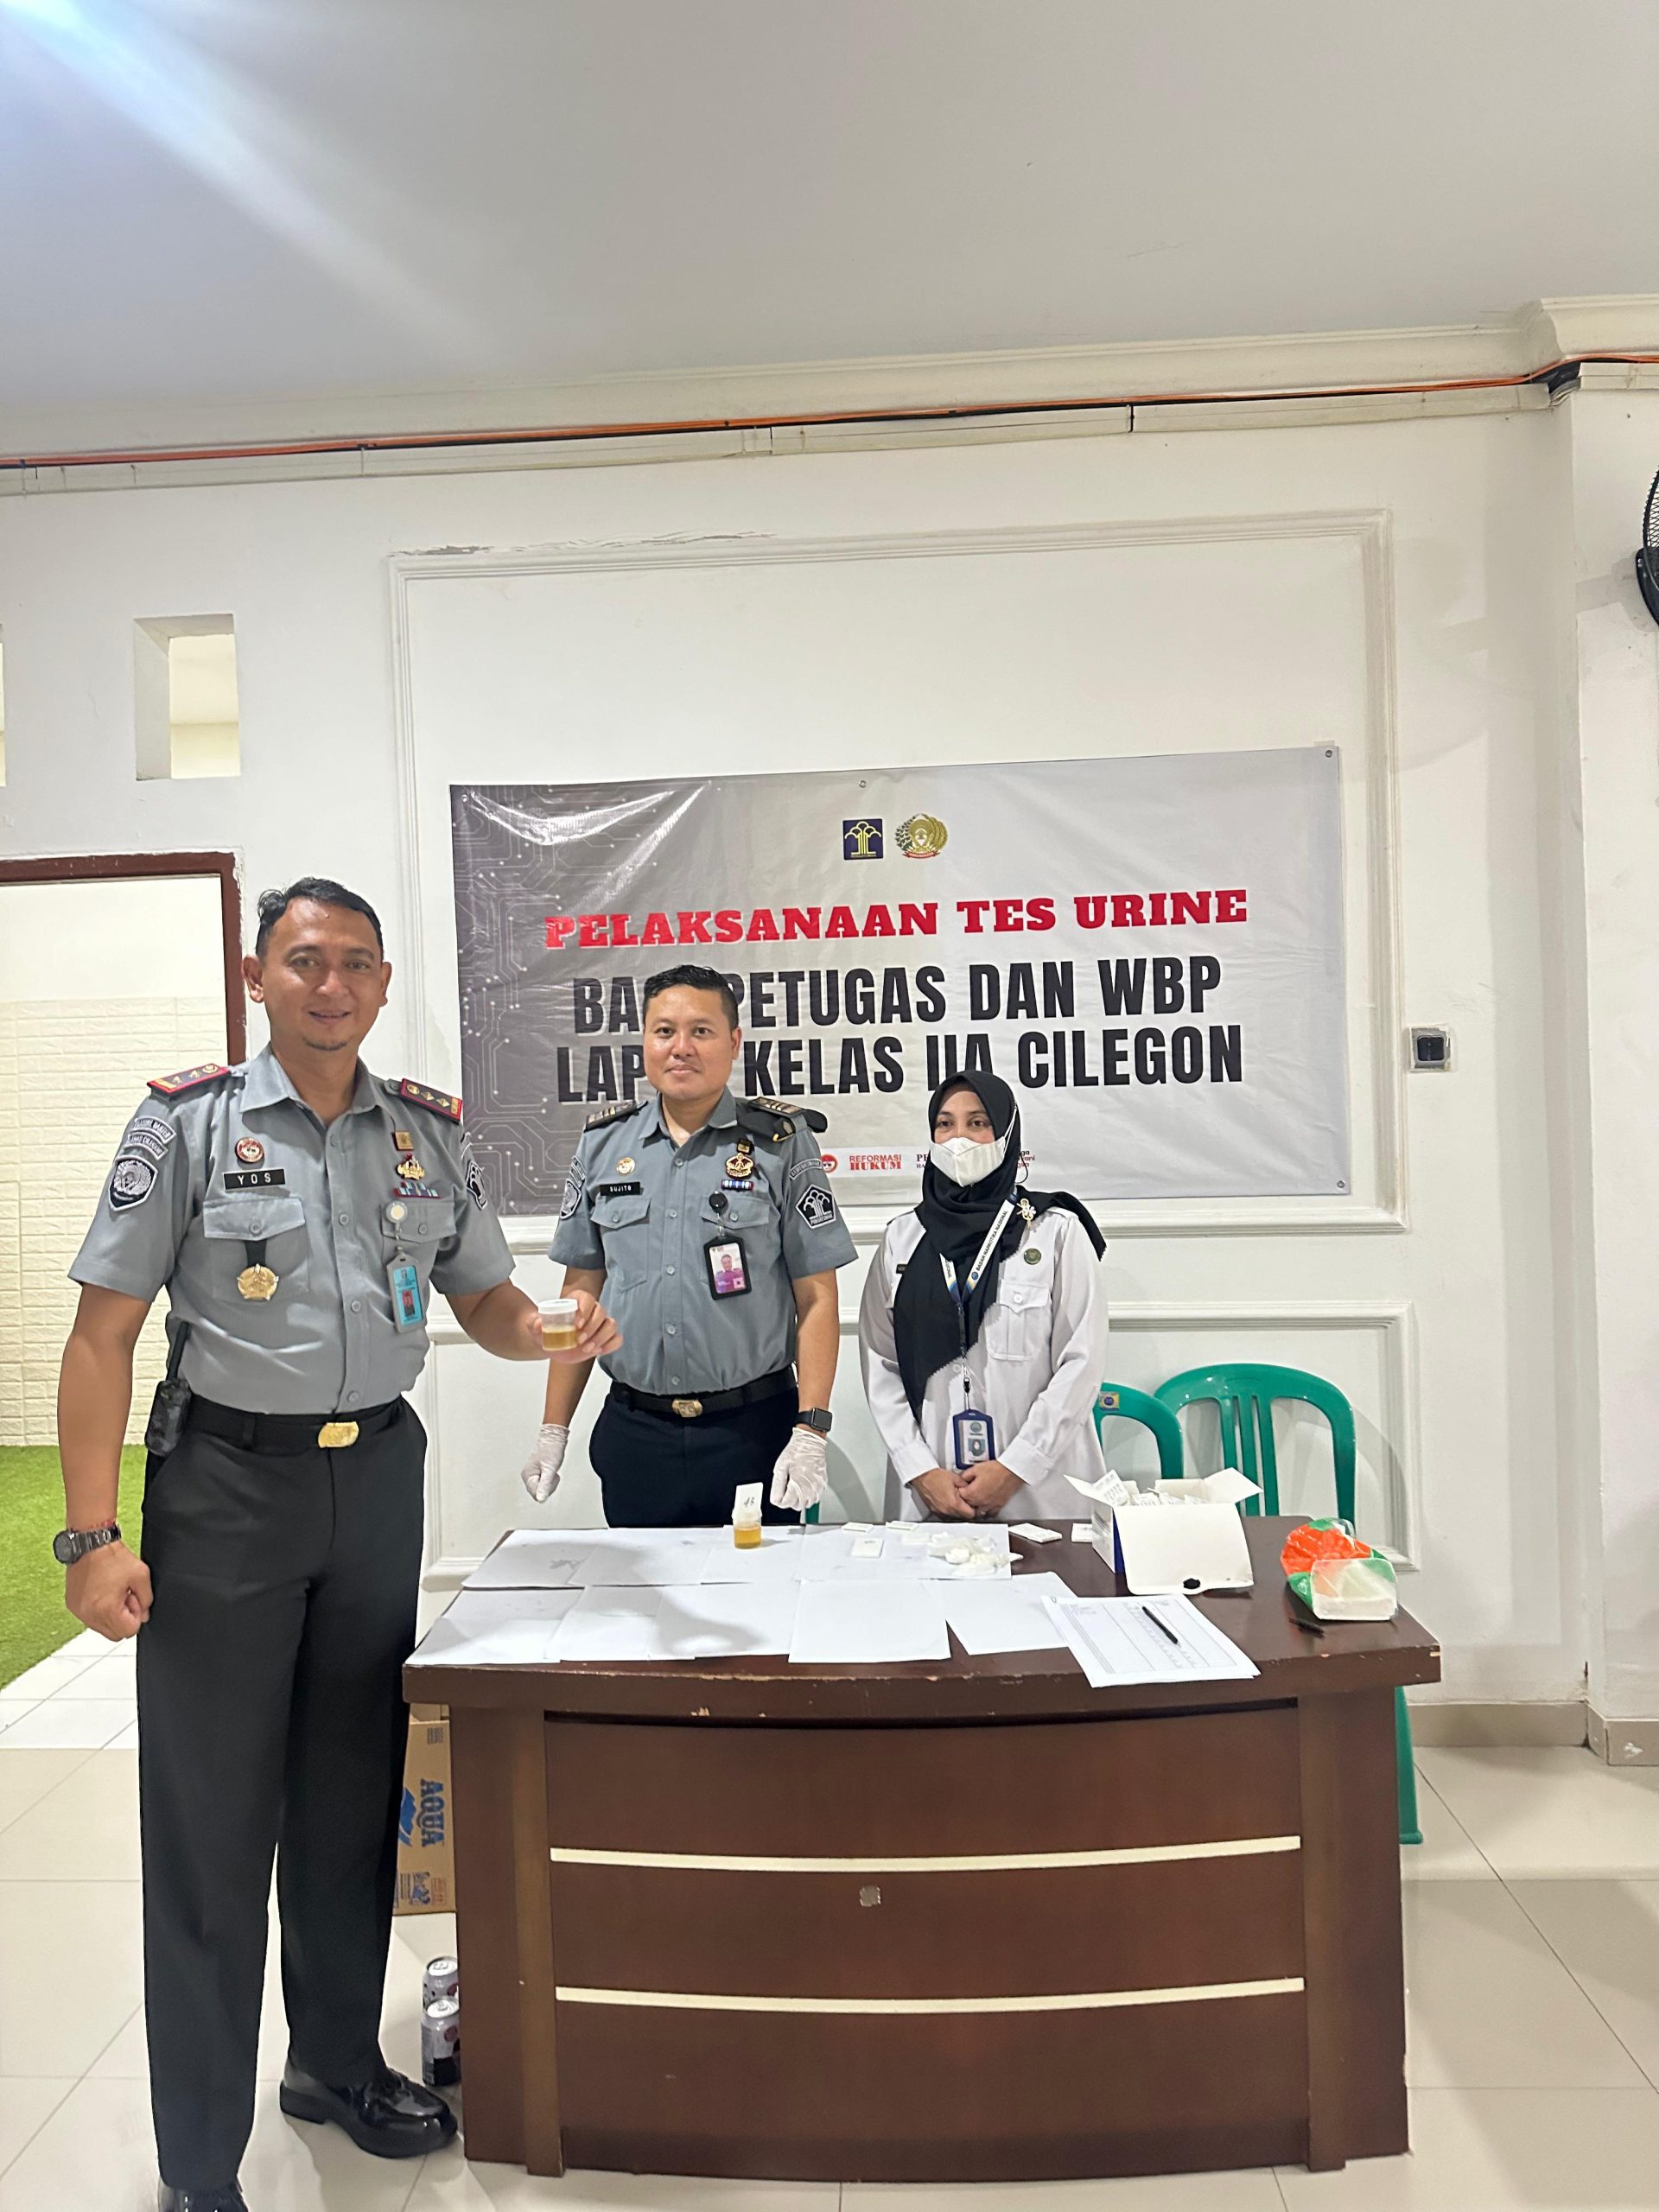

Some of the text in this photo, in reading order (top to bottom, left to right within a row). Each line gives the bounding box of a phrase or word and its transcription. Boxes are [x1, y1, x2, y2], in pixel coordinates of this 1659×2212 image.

[544, 889, 1247, 949] PELAKSANAAN TES URINE
[573, 976, 641, 1033] BA
[969, 960, 1075, 1020] DAN
[1098, 955, 1221, 1016] WBP
[556, 1045, 646, 1103] LAP
[743, 1035, 904, 1096] KELAS
[1018, 1024, 1243, 1089] CILEGON
[237, 1173, 271, 1185] YOS
[850, 1160, 902, 1171] HUKUM
[416, 1778, 445, 1847] AQUA
